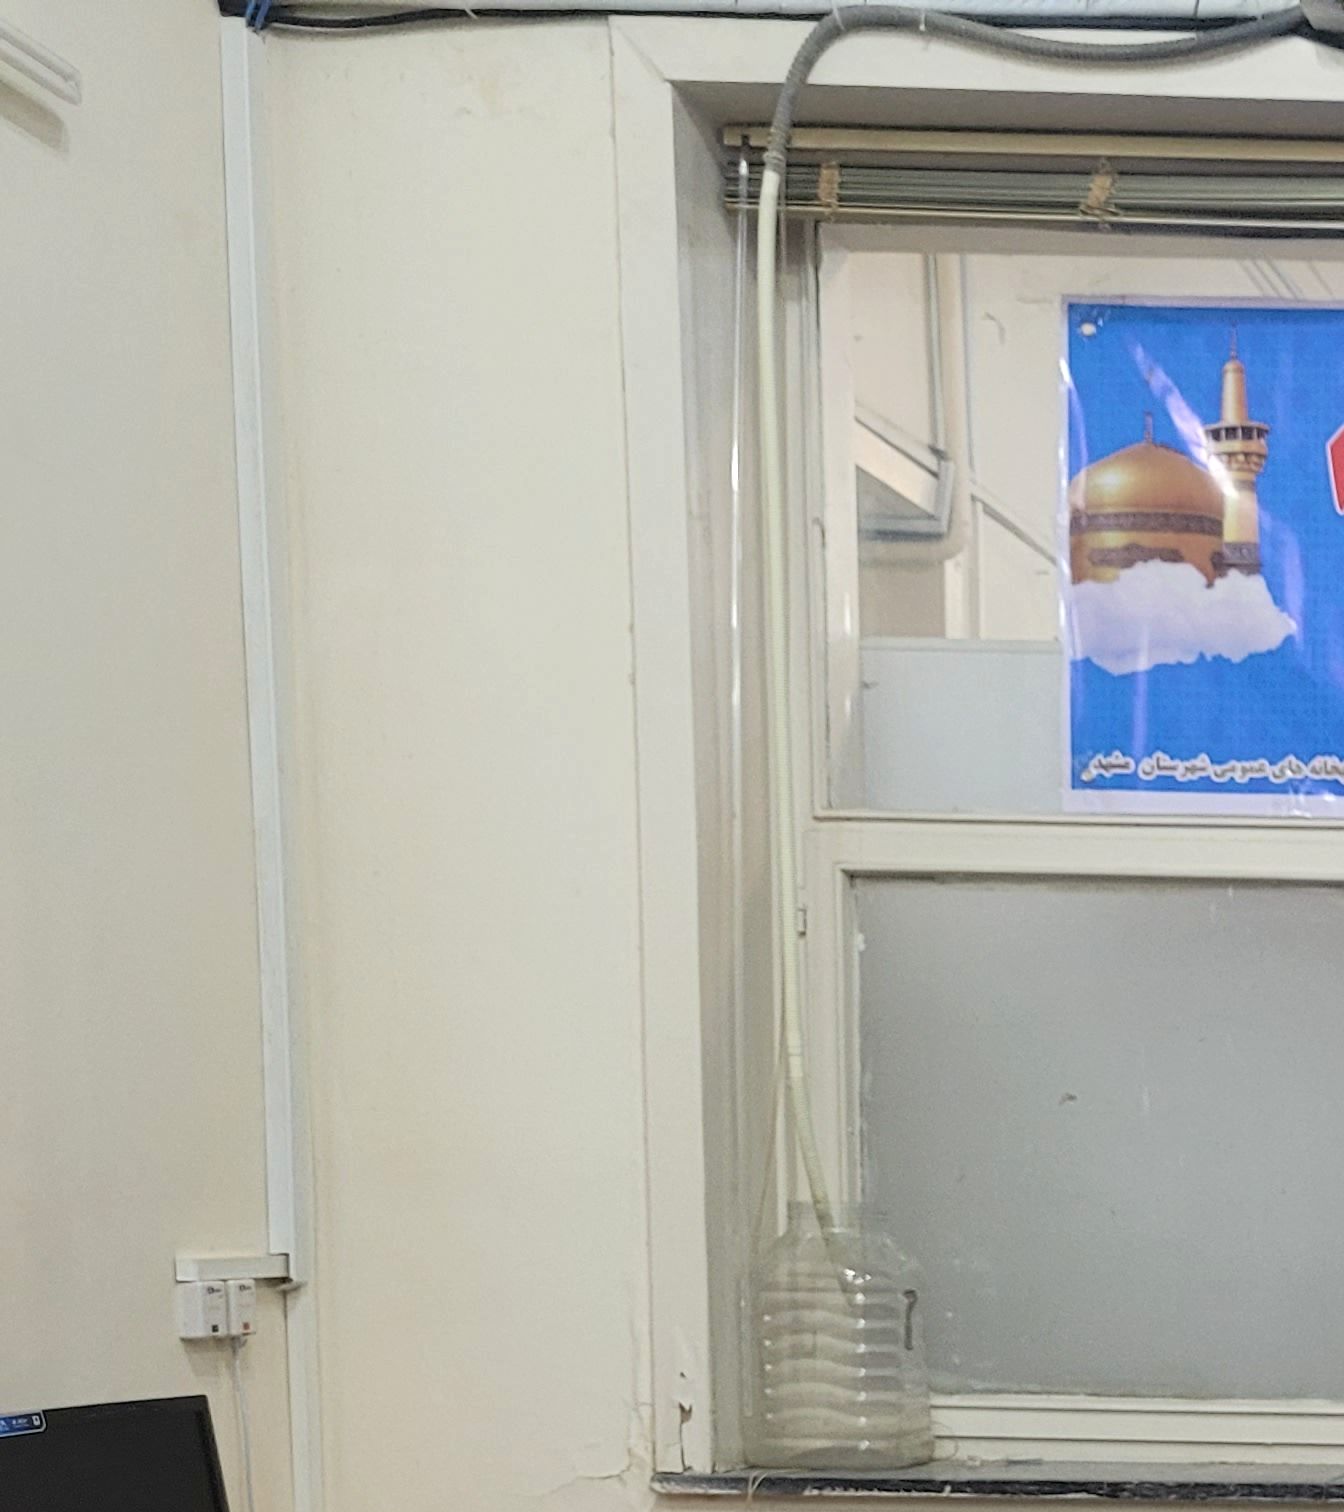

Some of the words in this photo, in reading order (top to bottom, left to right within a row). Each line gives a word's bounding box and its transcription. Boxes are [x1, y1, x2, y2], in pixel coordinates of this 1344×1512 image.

[1091, 750, 1135, 775] مشهد
[1137, 751, 1210, 781] شهرستان
[1210, 757, 1270, 783] عمومی
